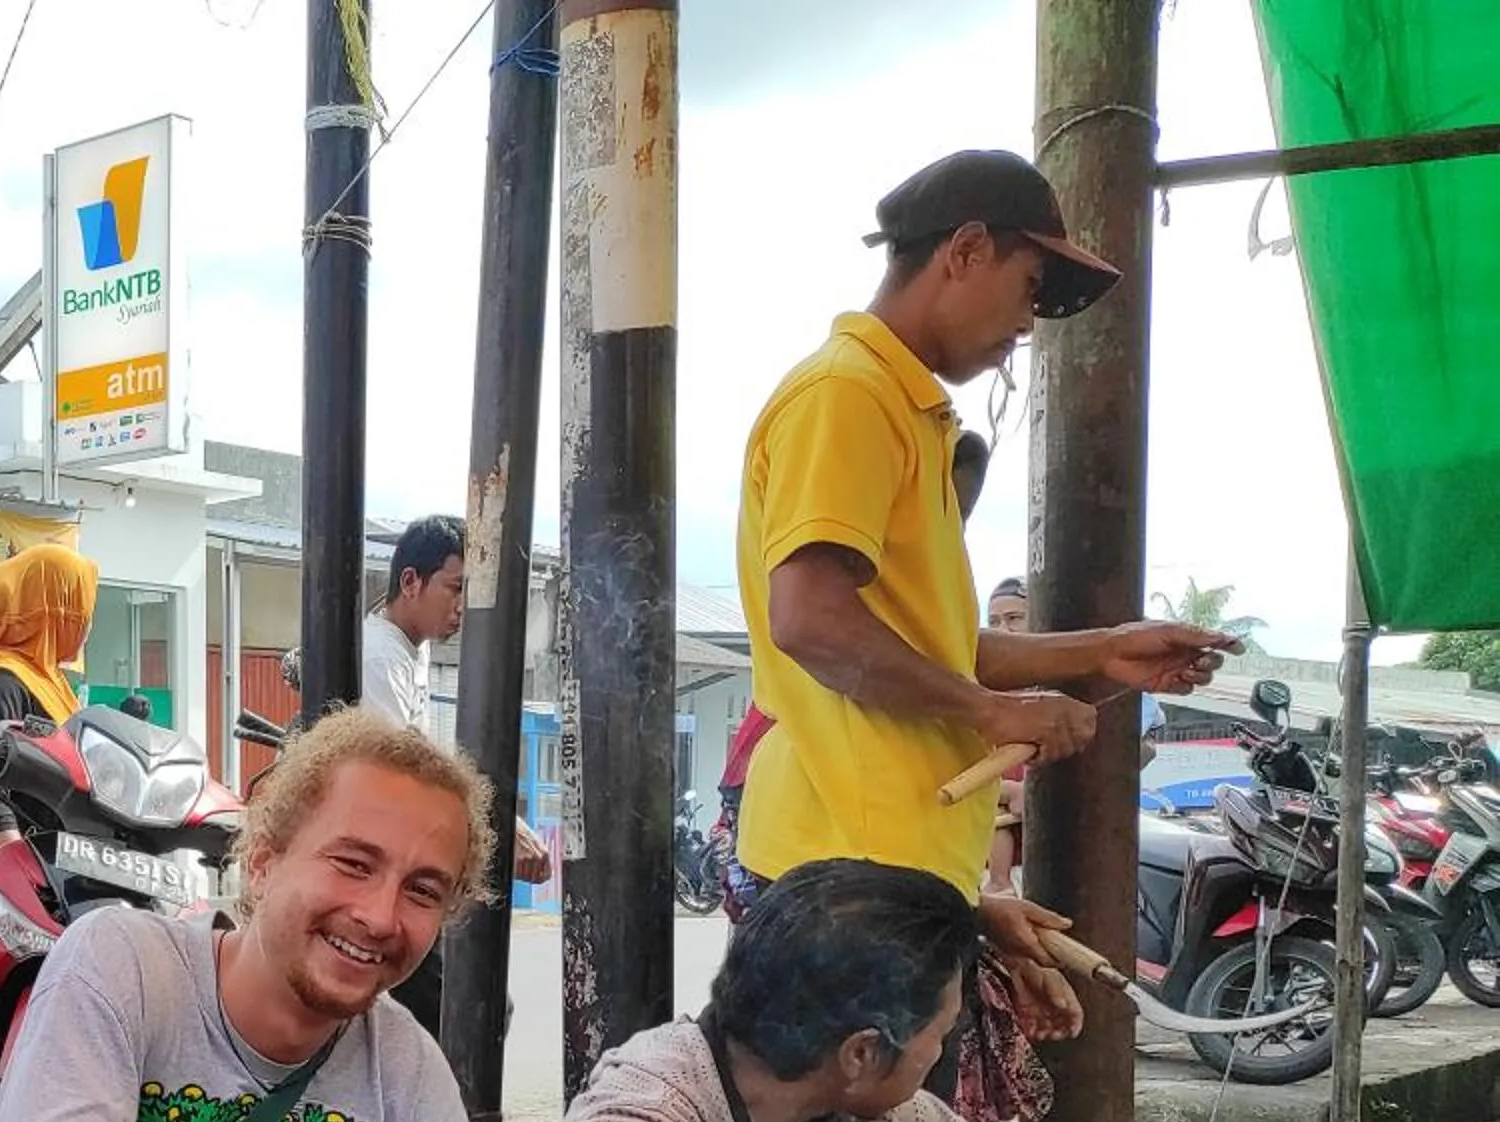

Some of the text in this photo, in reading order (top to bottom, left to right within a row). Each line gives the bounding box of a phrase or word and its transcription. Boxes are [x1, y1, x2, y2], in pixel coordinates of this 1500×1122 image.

[63, 269, 161, 315] BankNTB
[107, 363, 164, 399] atm
[63, 835, 96, 862] DR
